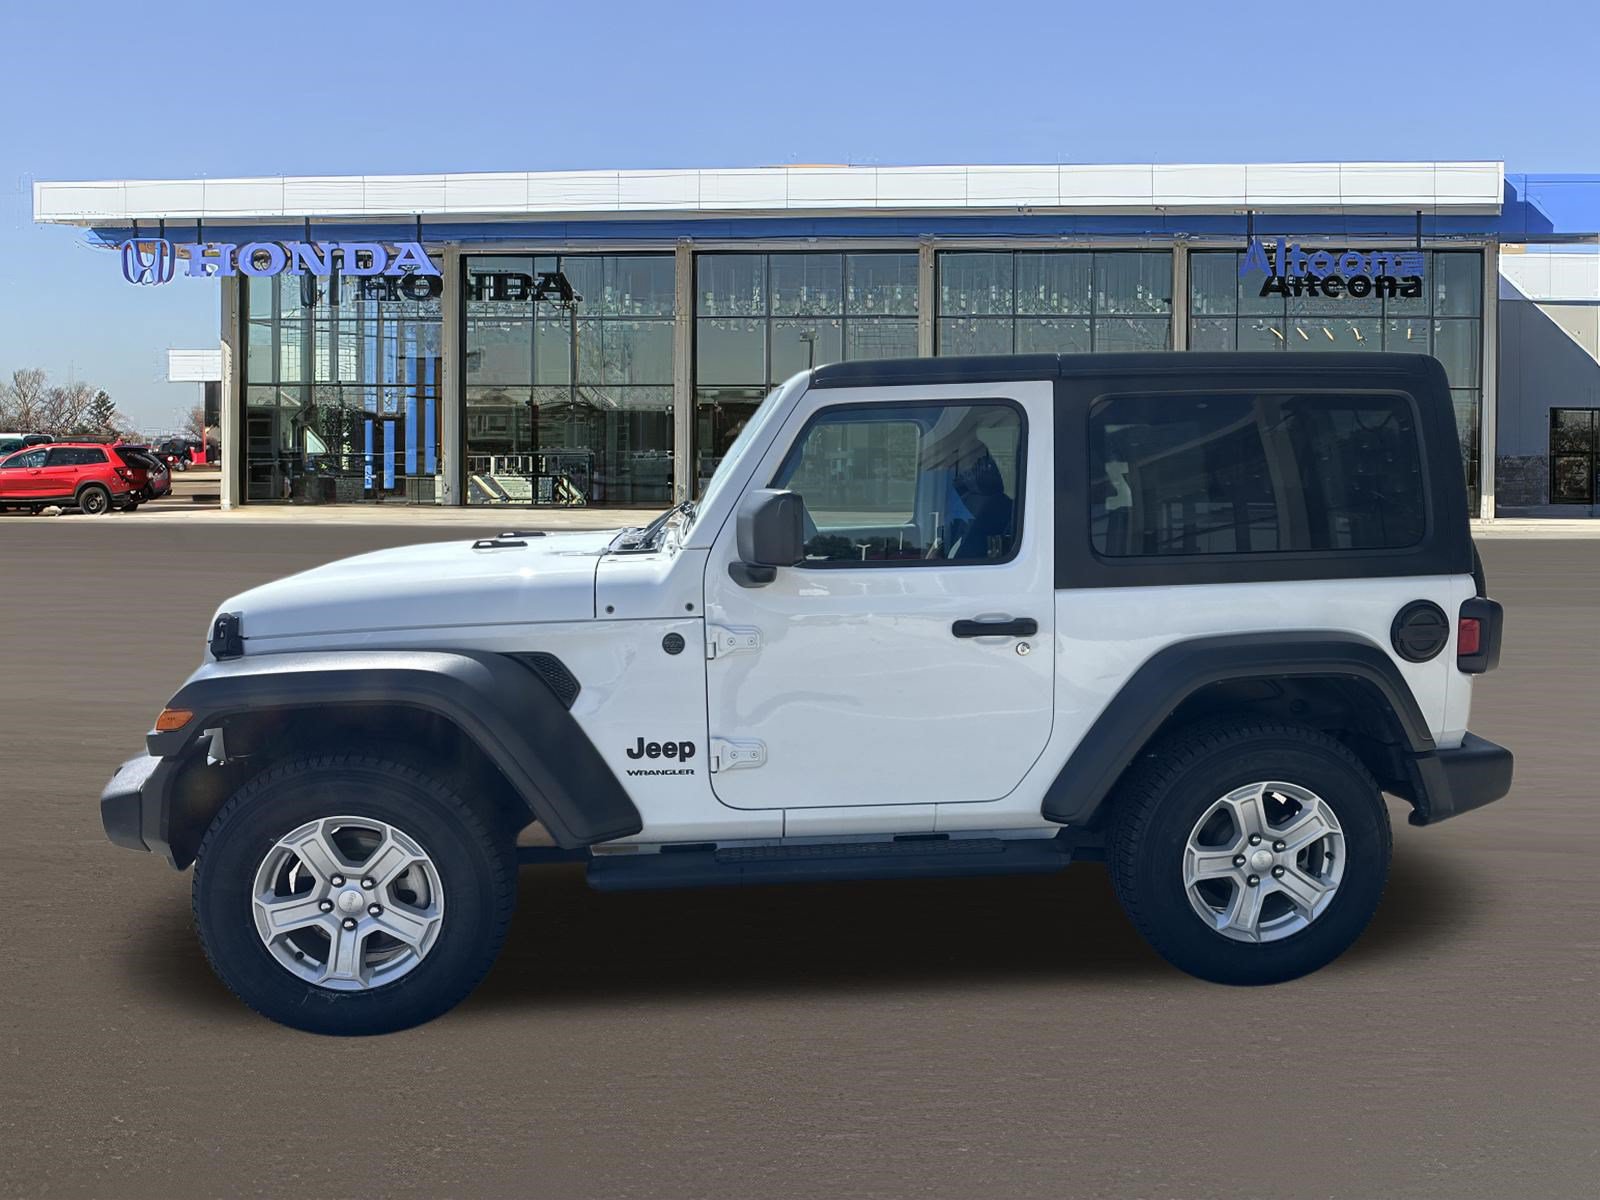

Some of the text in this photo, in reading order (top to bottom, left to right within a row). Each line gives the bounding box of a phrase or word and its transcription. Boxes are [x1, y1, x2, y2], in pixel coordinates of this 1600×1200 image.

[184, 241, 442, 277] HONDA
[626, 736, 696, 763] Jeep
[626, 769, 695, 777] WRANGLER
